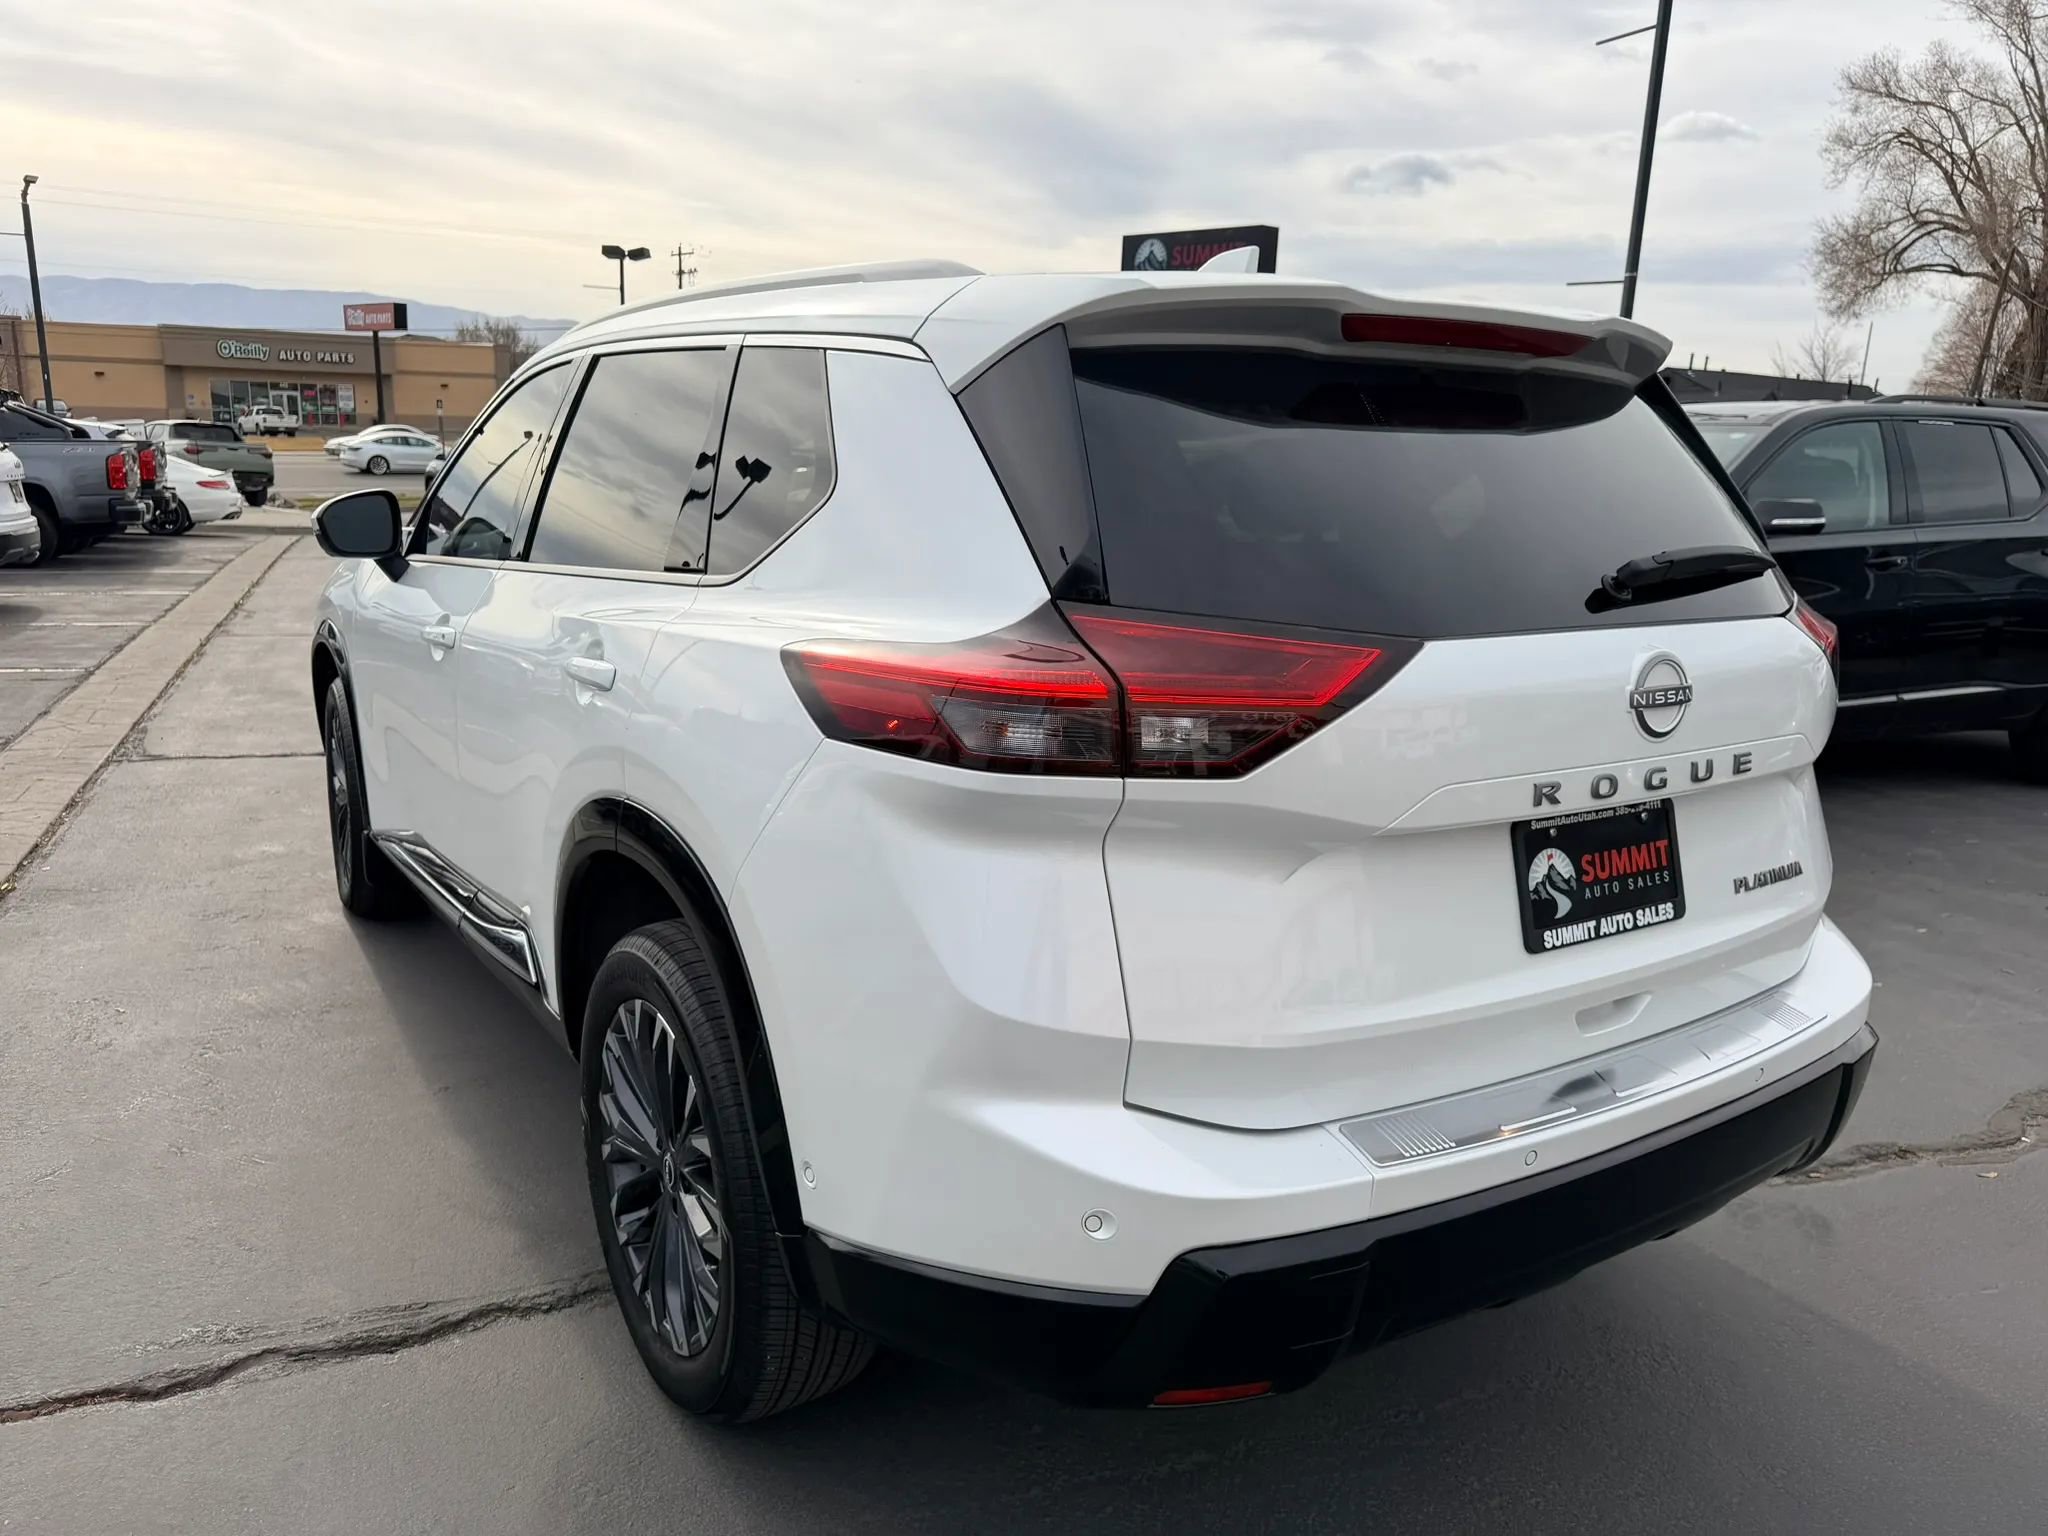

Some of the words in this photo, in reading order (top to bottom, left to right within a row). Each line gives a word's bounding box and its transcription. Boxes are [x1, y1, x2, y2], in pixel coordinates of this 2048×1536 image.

[1171, 241, 1247, 266] SUM
[216, 339, 270, 361] O'Reilly
[279, 351, 311, 362] AUTO
[317, 351, 355, 364] PARTS
[1633, 688, 1693, 706] NISSAN
[1533, 752, 1753, 807] ROGUE
[1531, 809, 1614, 830] SummitAutoUtah.com
[1581, 839, 1670, 884] SUMMIT
[1584, 881, 1620, 900] AUTO
[1628, 870, 1670, 890] SALES
[1733, 860, 1804, 895] PLATINUM
[1543, 920, 1597, 950] SUMMIT
[1600, 912, 1634, 937] AUTO
[1636, 902, 1675, 926] SALES
